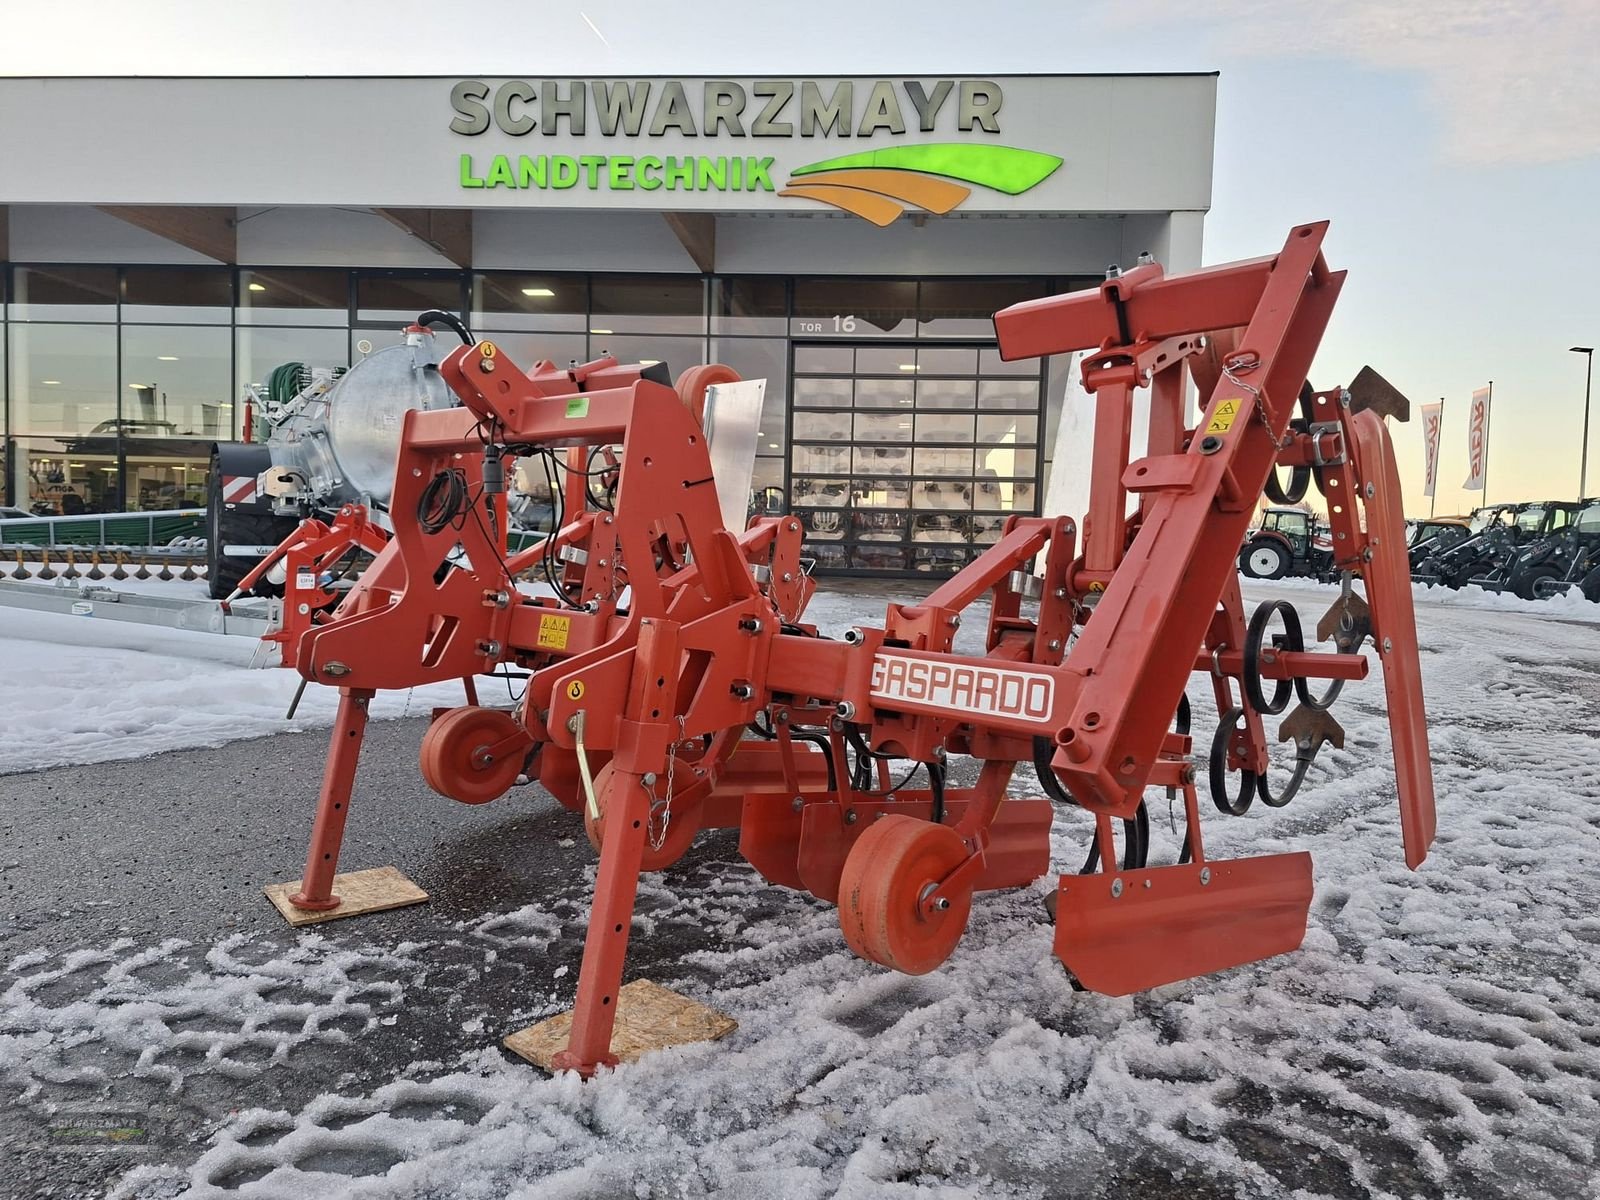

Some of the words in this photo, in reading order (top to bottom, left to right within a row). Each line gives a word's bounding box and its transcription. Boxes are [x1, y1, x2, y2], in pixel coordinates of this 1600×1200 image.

[449, 80, 1004, 138] SCHWARZMAYR
[459, 154, 776, 192] LANDTECHNIK
[800, 323, 822, 332] TOR
[832, 315, 856, 333] 16
[871, 658, 1051, 718] GASPARDO
